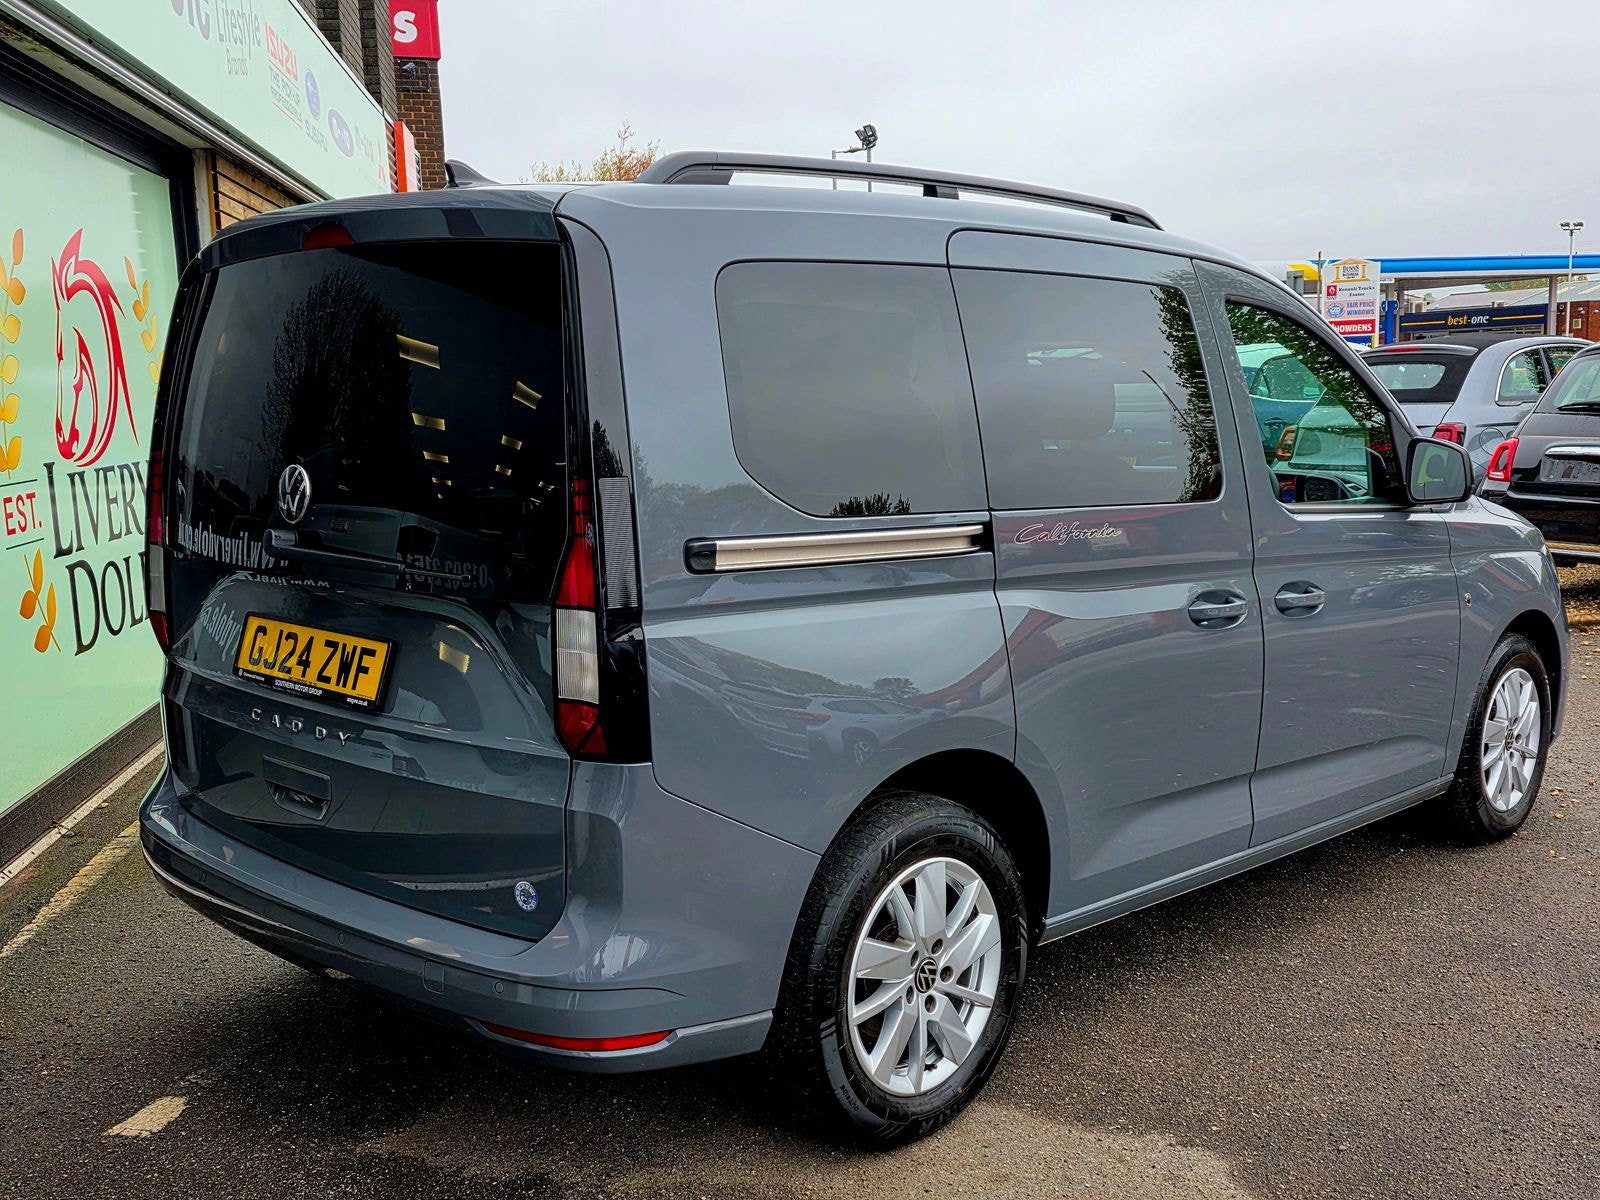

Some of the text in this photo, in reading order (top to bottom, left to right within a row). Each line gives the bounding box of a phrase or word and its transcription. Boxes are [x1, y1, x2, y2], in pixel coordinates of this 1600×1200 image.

[393, 10, 418, 43] S
[264, 21, 299, 82] ISUZU
[1447, 314, 1490, 325] best-one
[3, 491, 43, 537] EST.
[1013, 521, 1122, 545] California
[65, 553, 150, 656] DOL
[248, 624, 377, 691] GJ24 ZWF
[251, 708, 351, 746] CADDY
